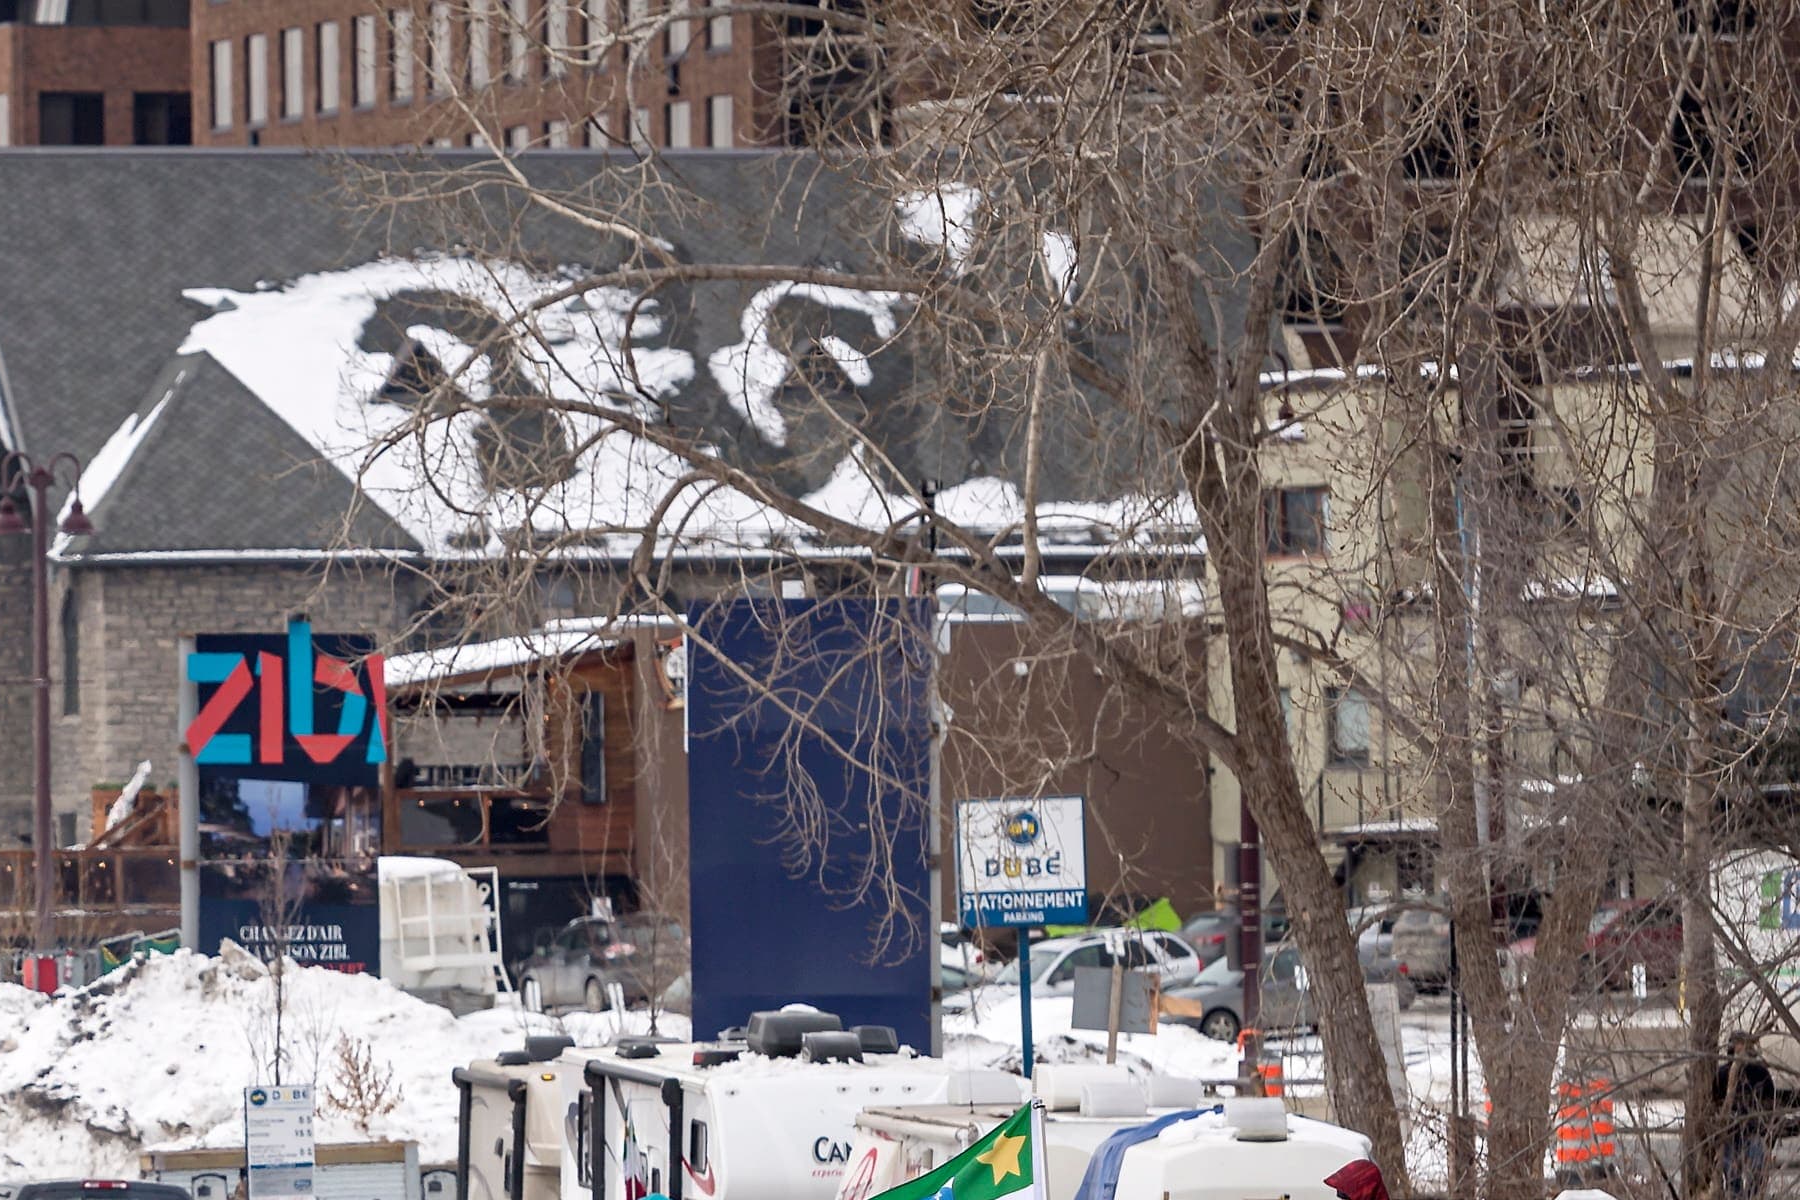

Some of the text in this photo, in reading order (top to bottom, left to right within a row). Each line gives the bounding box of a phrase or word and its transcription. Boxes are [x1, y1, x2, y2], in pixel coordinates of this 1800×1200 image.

[986, 852, 1060, 877] DUBÉ
[963, 891, 1084, 910] STATIONNEMENT
[1004, 911, 1044, 922] PARKING
[239, 924, 343, 942] CHANEZ D'AIR
